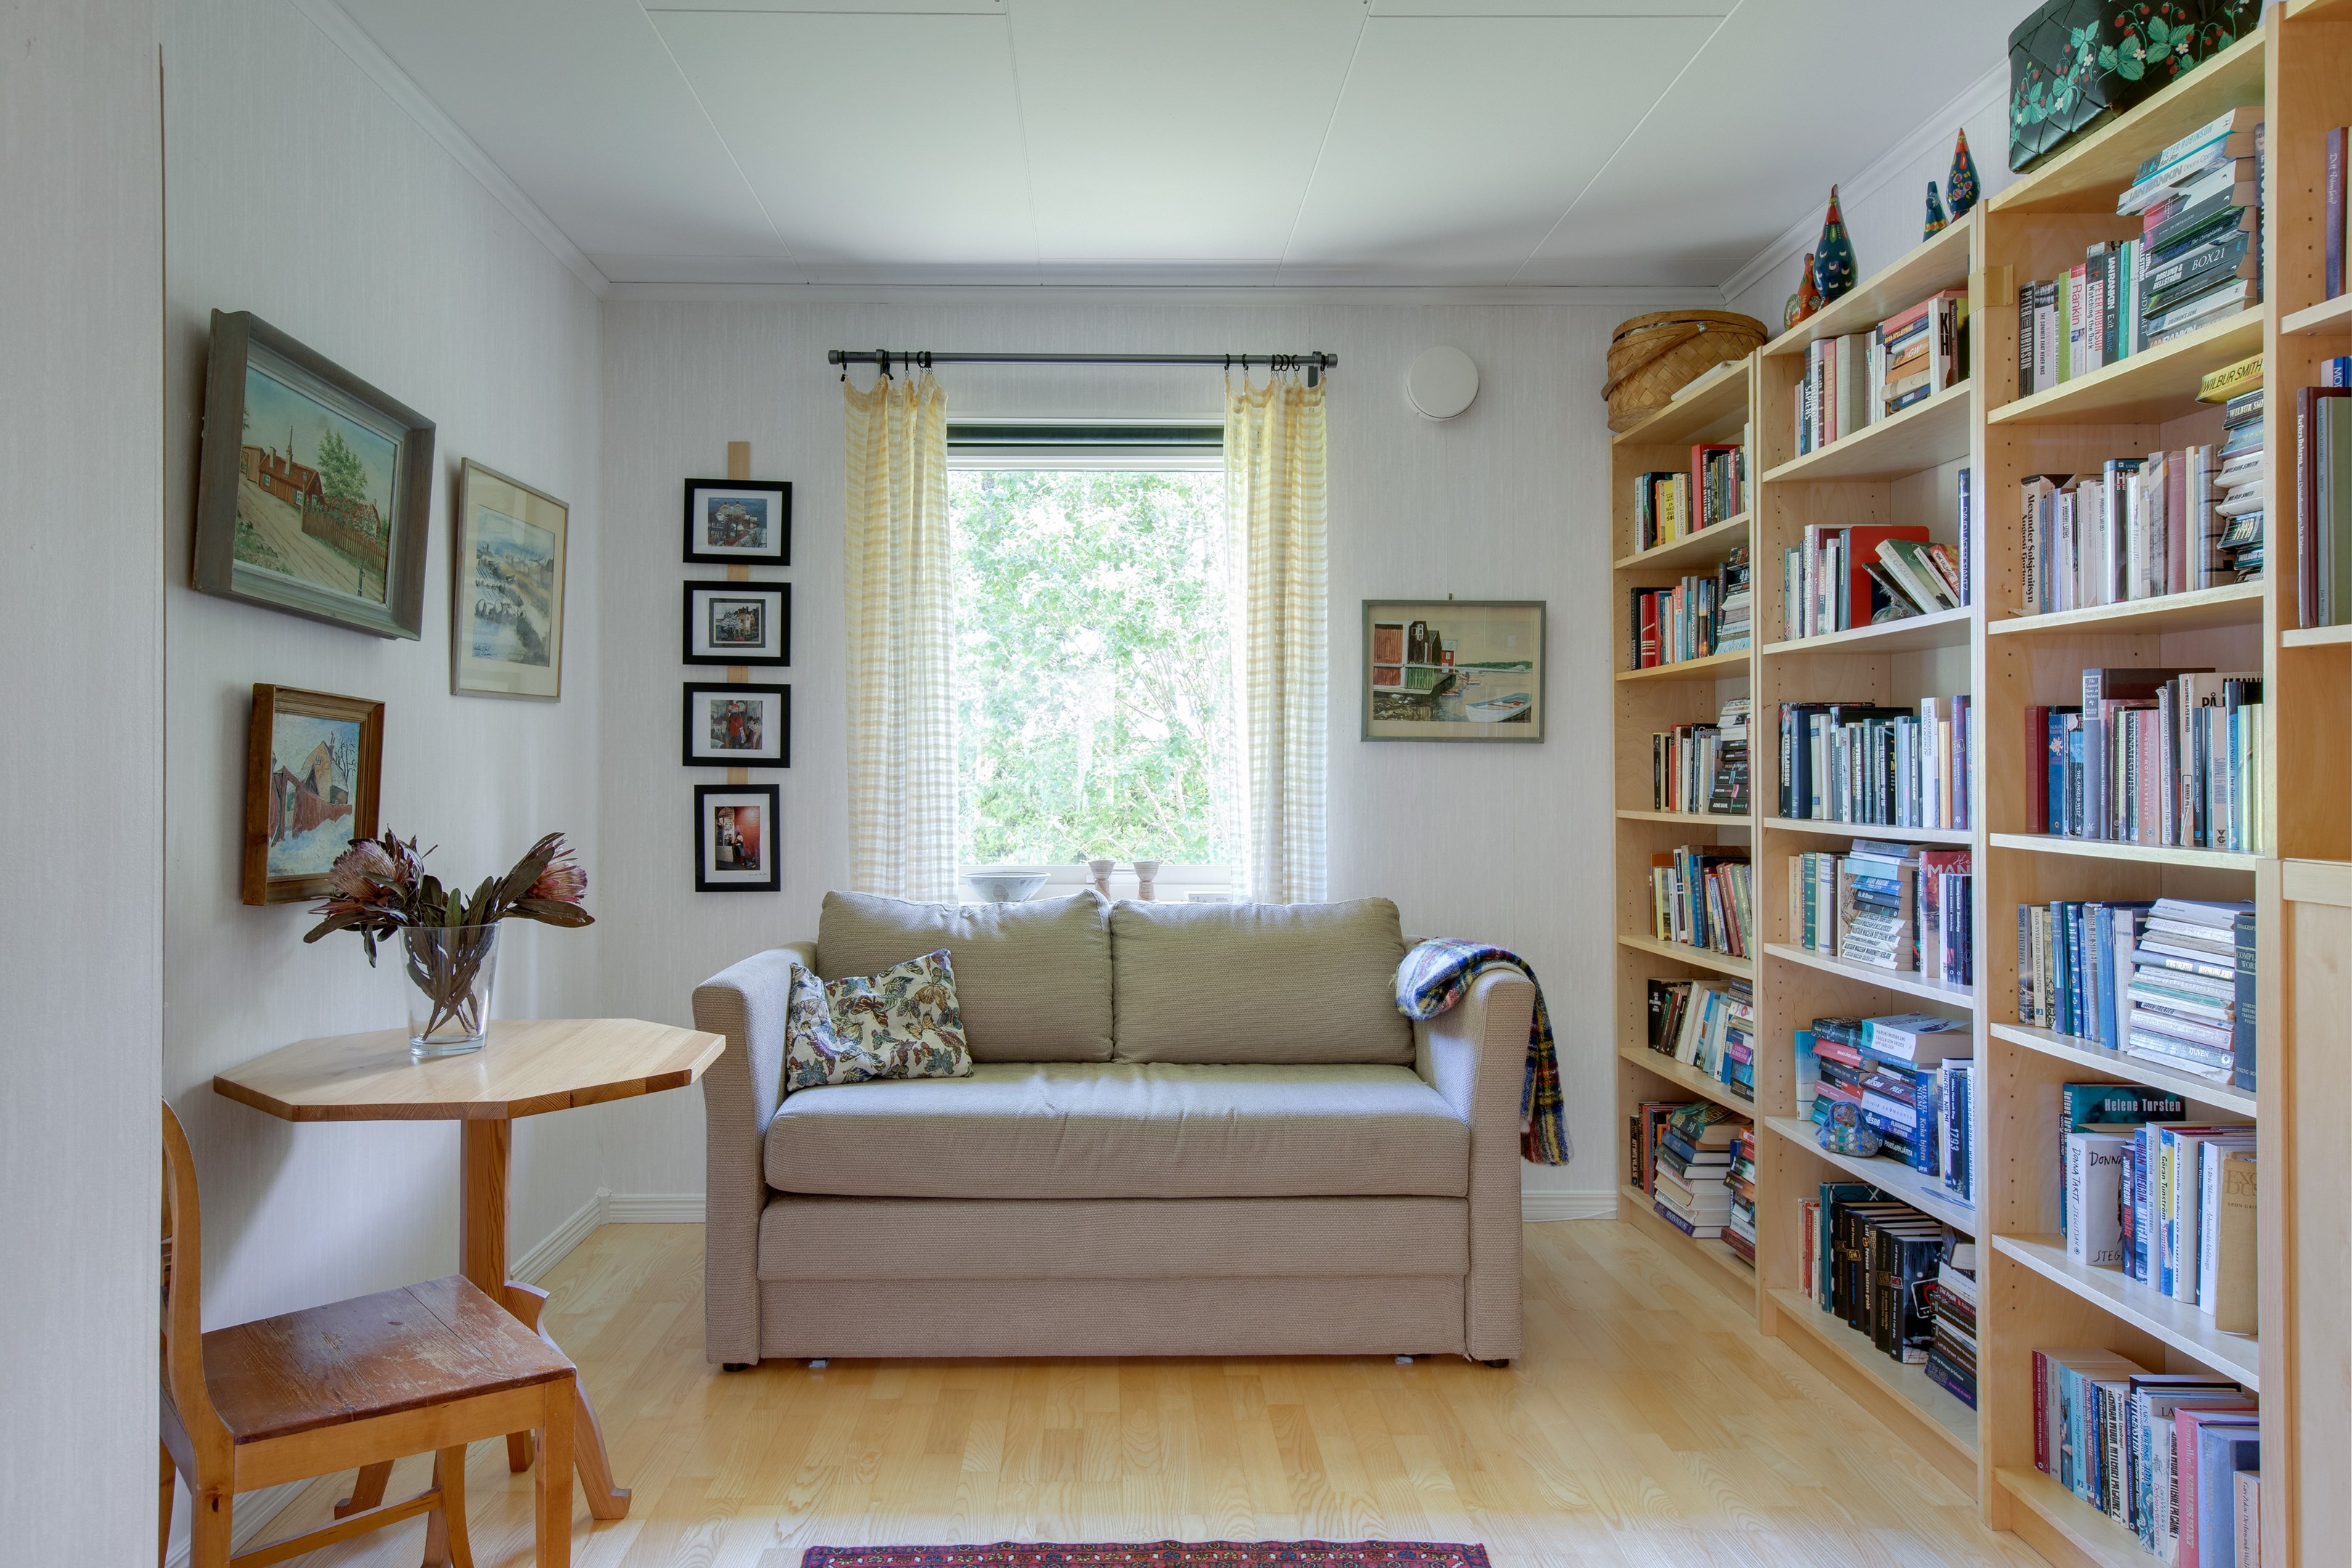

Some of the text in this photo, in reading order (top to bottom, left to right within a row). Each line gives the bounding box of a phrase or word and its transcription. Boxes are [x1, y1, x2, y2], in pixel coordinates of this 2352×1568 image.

[2072, 284, 2083, 326] Rankin
[2021, 291, 2033, 369] PETER ROBINSON
[2107, 330, 2115, 354] Music
[2203, 358, 2263, 393] WILBUR SMITH
[2025, 544, 2036, 603] Solsjenitsyn
[1927, 865, 1972, 878] MAN
[1864, 1079, 1884, 1088] NESBØ
[1890, 1085, 1904, 1095] POLIS
[2064, 1091, 2073, 1114] Helene
[2104, 1098, 2181, 1112] Helene Tursten
[1865, 1114, 1881, 1127] NESBØ
[1950, 1127, 1959, 1151] 1793
[2072, 1148, 2081, 1175] DONNA
[2122, 1156, 2131, 1177] JOHAN
[2137, 1138, 2148, 1203] JOHAN THEORIN
[2123, 1180, 2131, 1206] THEORIN
[2131, 1393, 2139, 1455] WITTGENSTEIN
